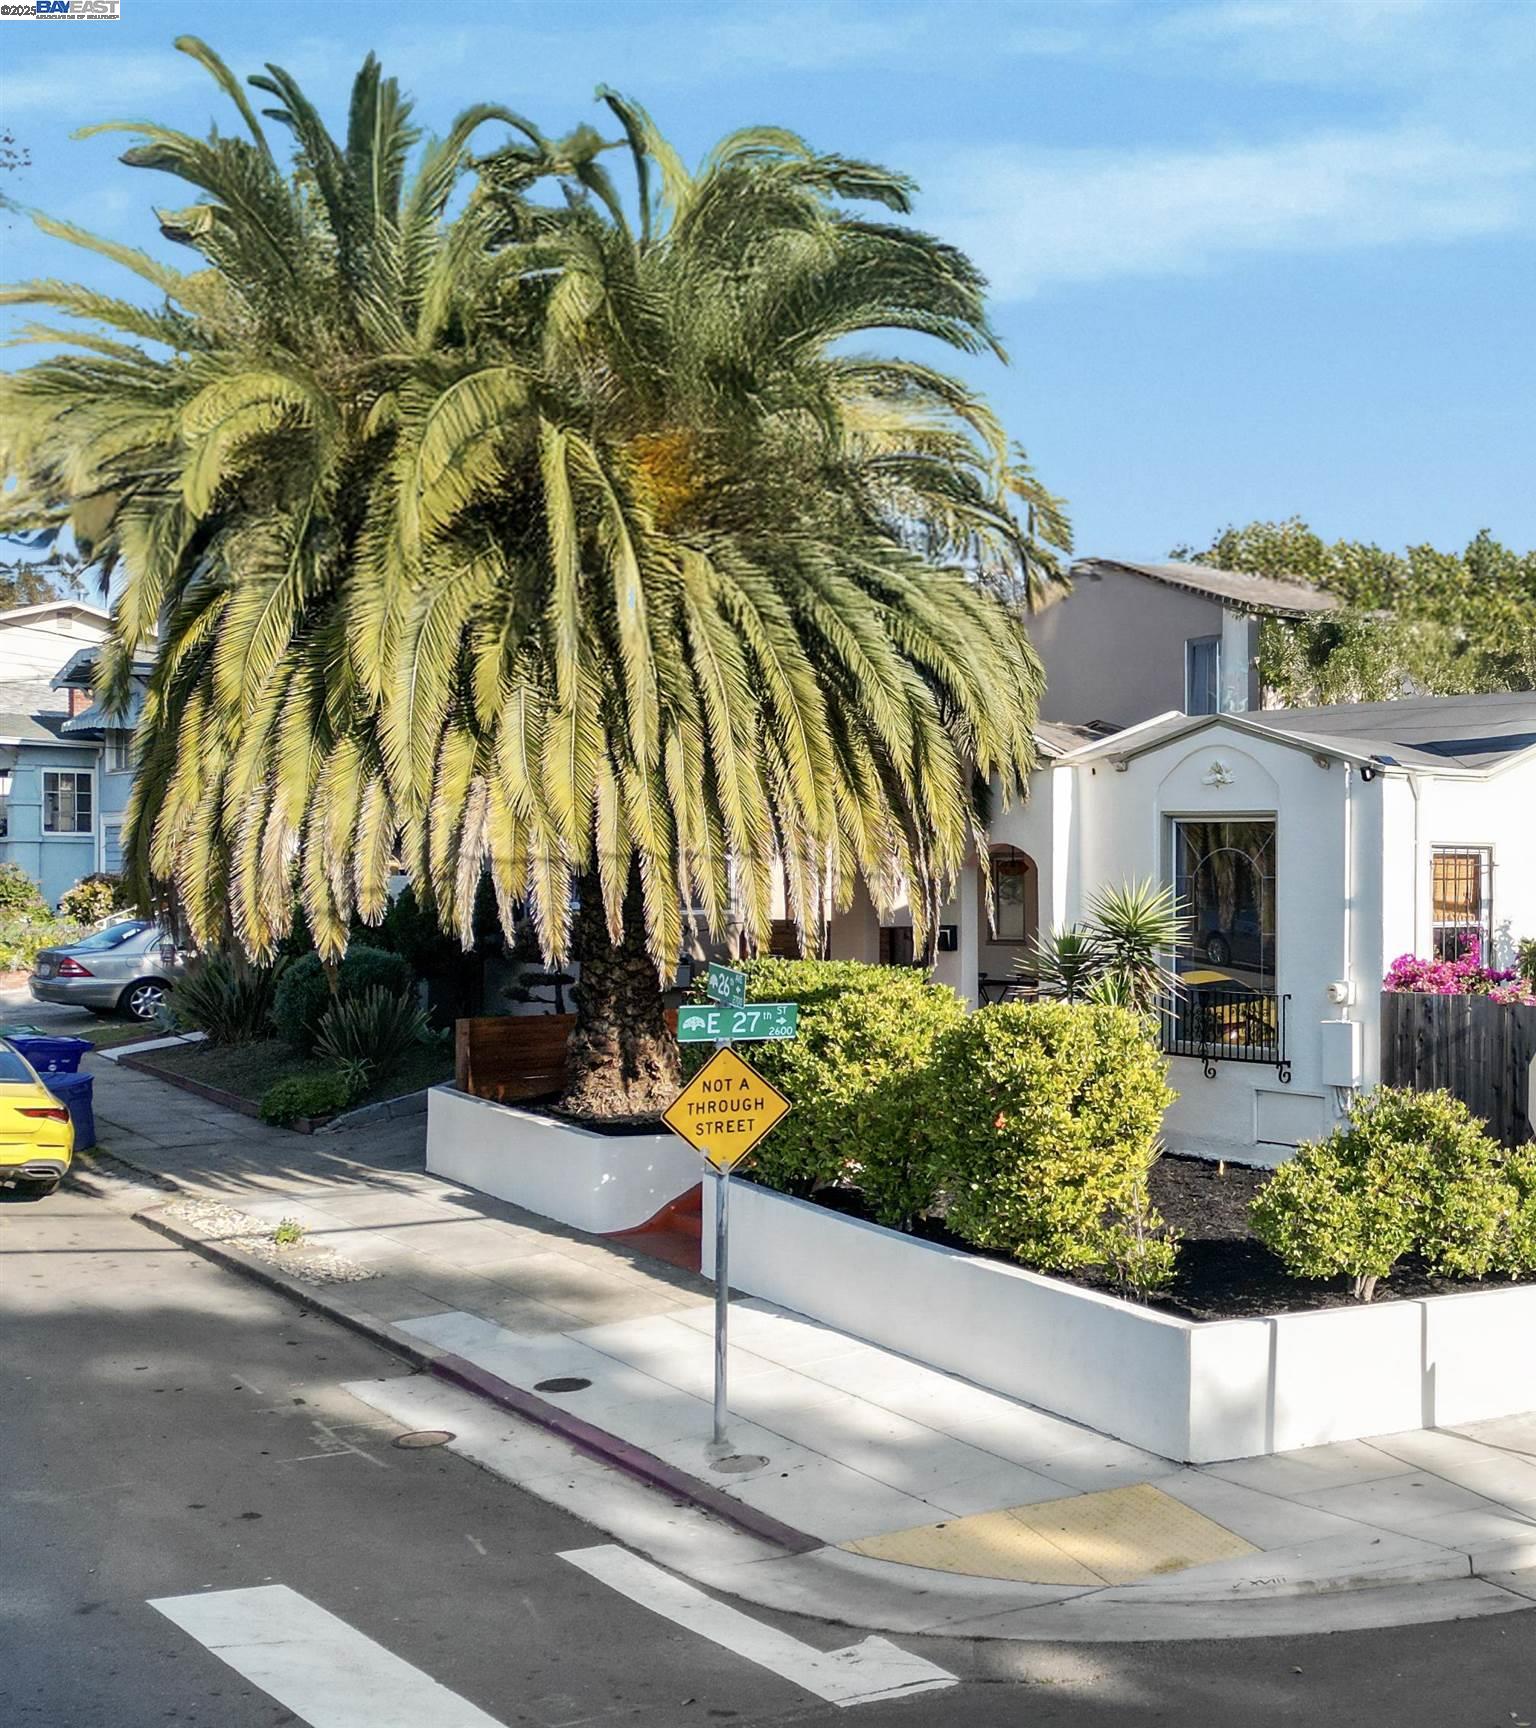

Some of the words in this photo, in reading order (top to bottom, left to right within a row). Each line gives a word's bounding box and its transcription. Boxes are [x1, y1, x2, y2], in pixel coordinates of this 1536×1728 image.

[707, 1012, 721, 1034] E
[777, 1006, 787, 1015] ST
[768, 1026, 793, 1036] 2600
[702, 1078, 732, 1093] NOT
[739, 1078, 749, 1091] A
[687, 1097, 765, 1116] THROUGH
[696, 1119, 755, 1136] STREET
